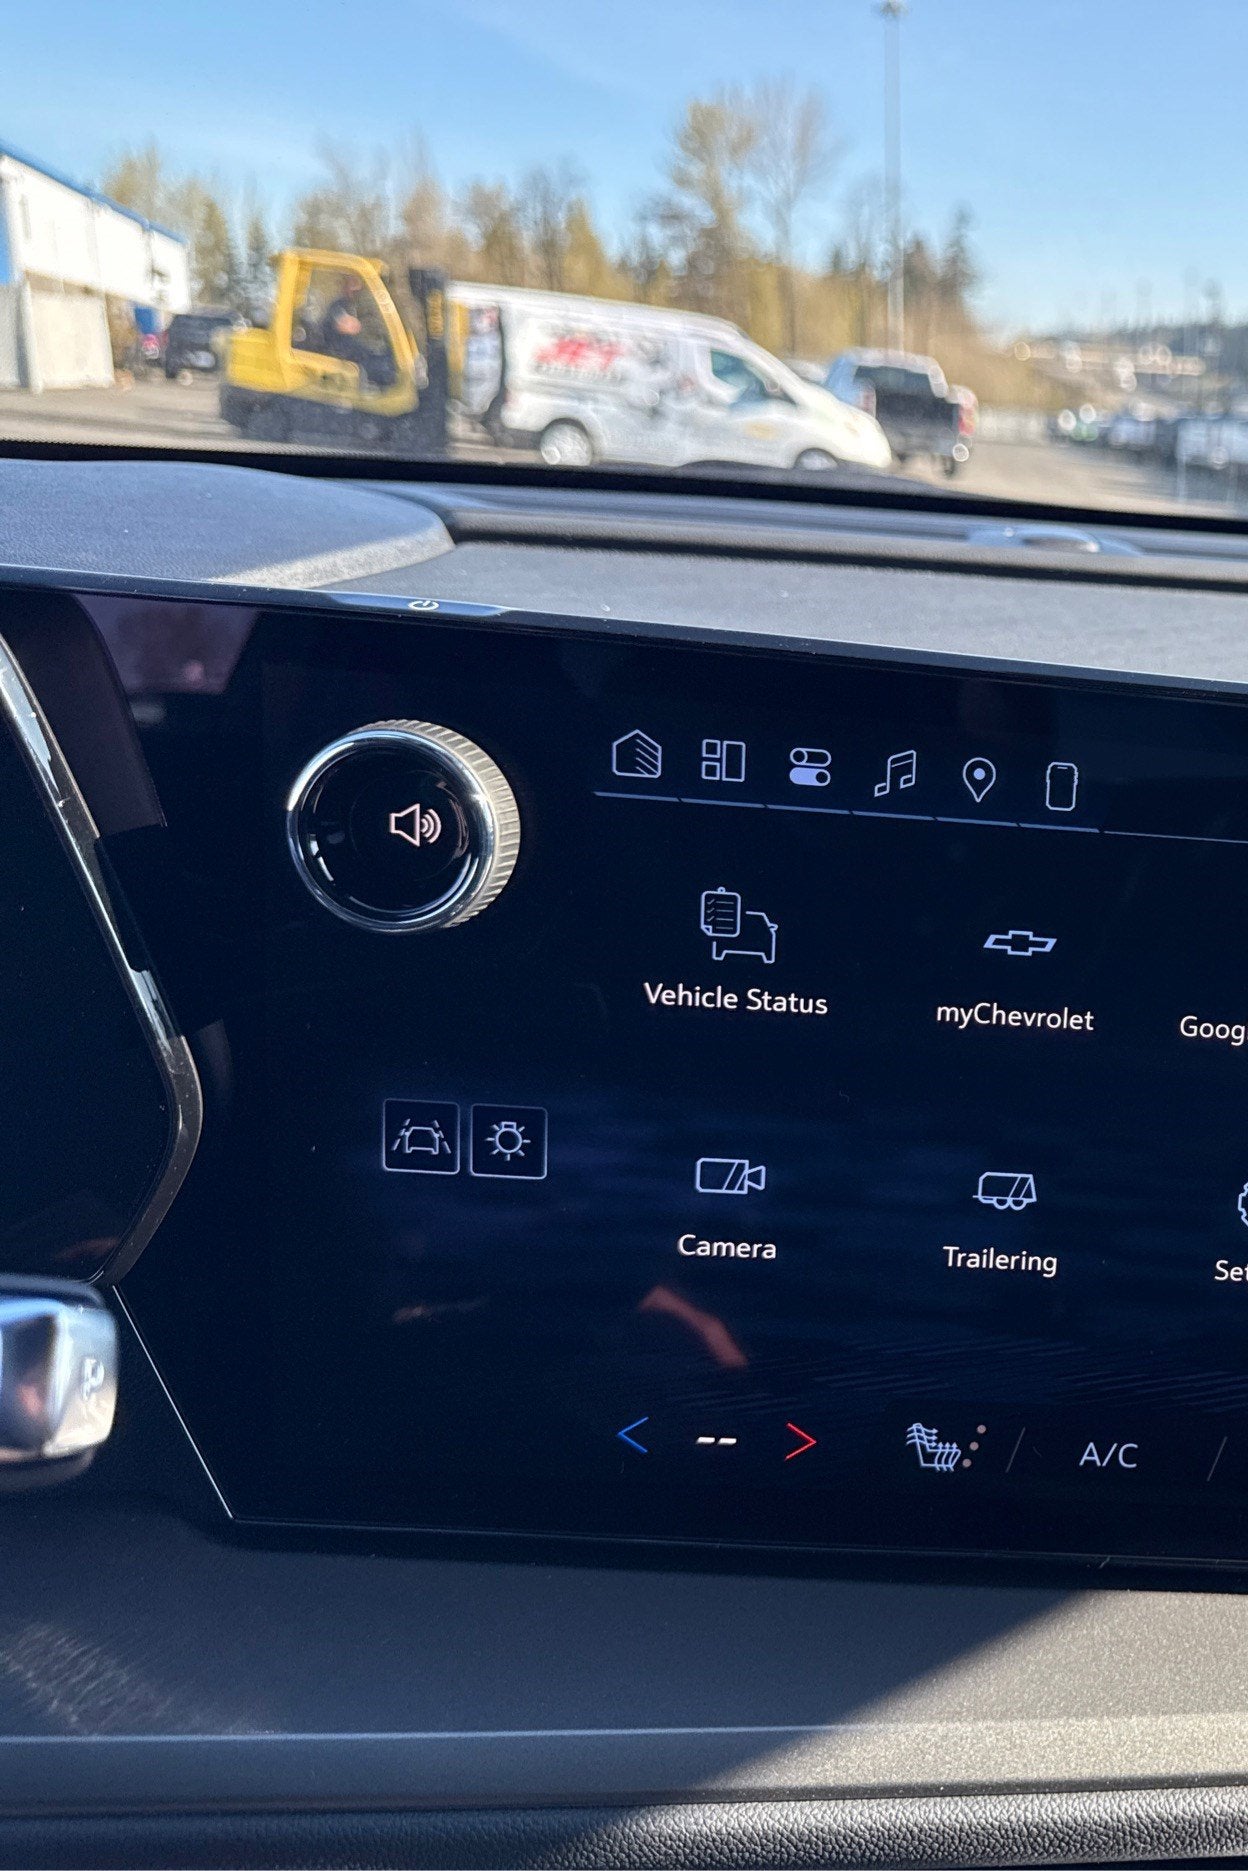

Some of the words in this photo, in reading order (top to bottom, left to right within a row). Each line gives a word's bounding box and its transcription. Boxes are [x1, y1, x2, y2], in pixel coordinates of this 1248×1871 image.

[643, 982, 740, 1010] Vehicle
[745, 988, 828, 1015] Status
[936, 1002, 1095, 1031] myChevrolet
[677, 1233, 777, 1259] Camera
[942, 1245, 1058, 1278] Trailering
[1079, 1441, 1139, 1469] A/C
